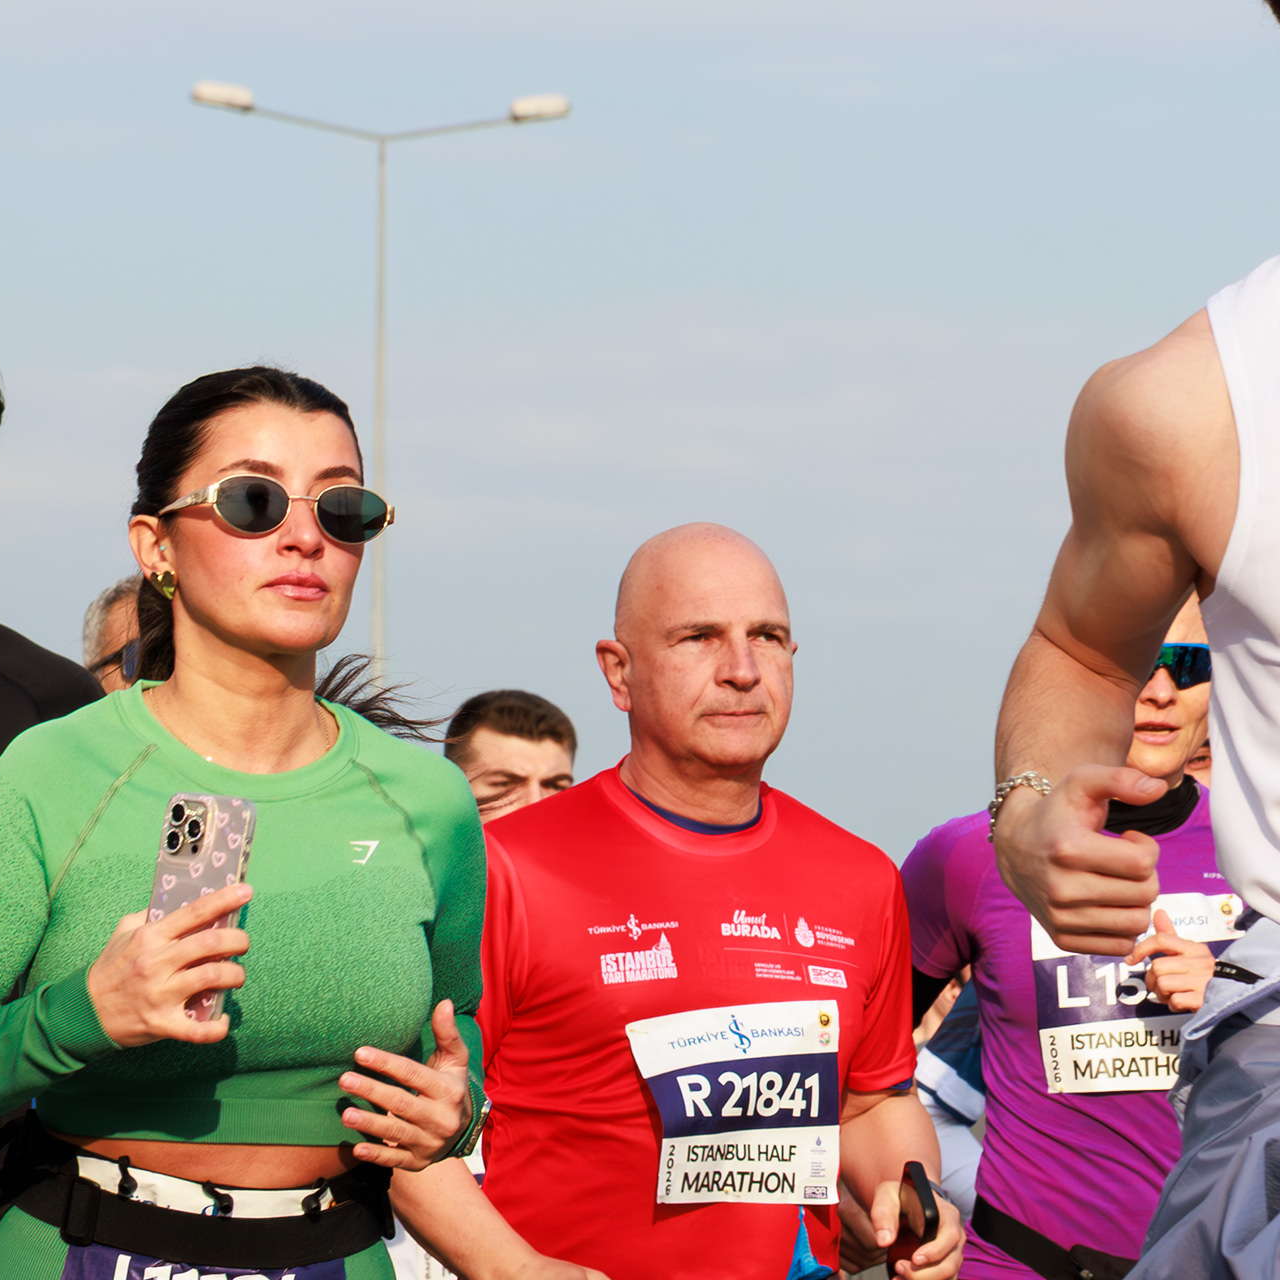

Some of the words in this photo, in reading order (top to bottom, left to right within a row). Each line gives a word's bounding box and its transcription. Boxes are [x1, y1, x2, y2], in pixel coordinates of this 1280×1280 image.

[721, 923, 781, 940] BURADA
[600, 950, 676, 973] İSTANBUL
[602, 970, 625, 985] YARI
[625, 966, 678, 983] MARATONU
[811, 968, 841, 979] SPOR
[1056, 965, 1090, 1008] L
[668, 1031, 729, 1050] TÜRKİYE
[751, 1027, 805, 1038] BANKASI
[1071, 1030, 1159, 1051] ISTANBUL
[676, 1074, 712, 1118] R
[718, 1071, 819, 1118] 21841
[686, 1144, 755, 1162] ISTANBUL
[757, 1145, 797, 1162] HALF
[681, 1171, 795, 1193] MARATHON
